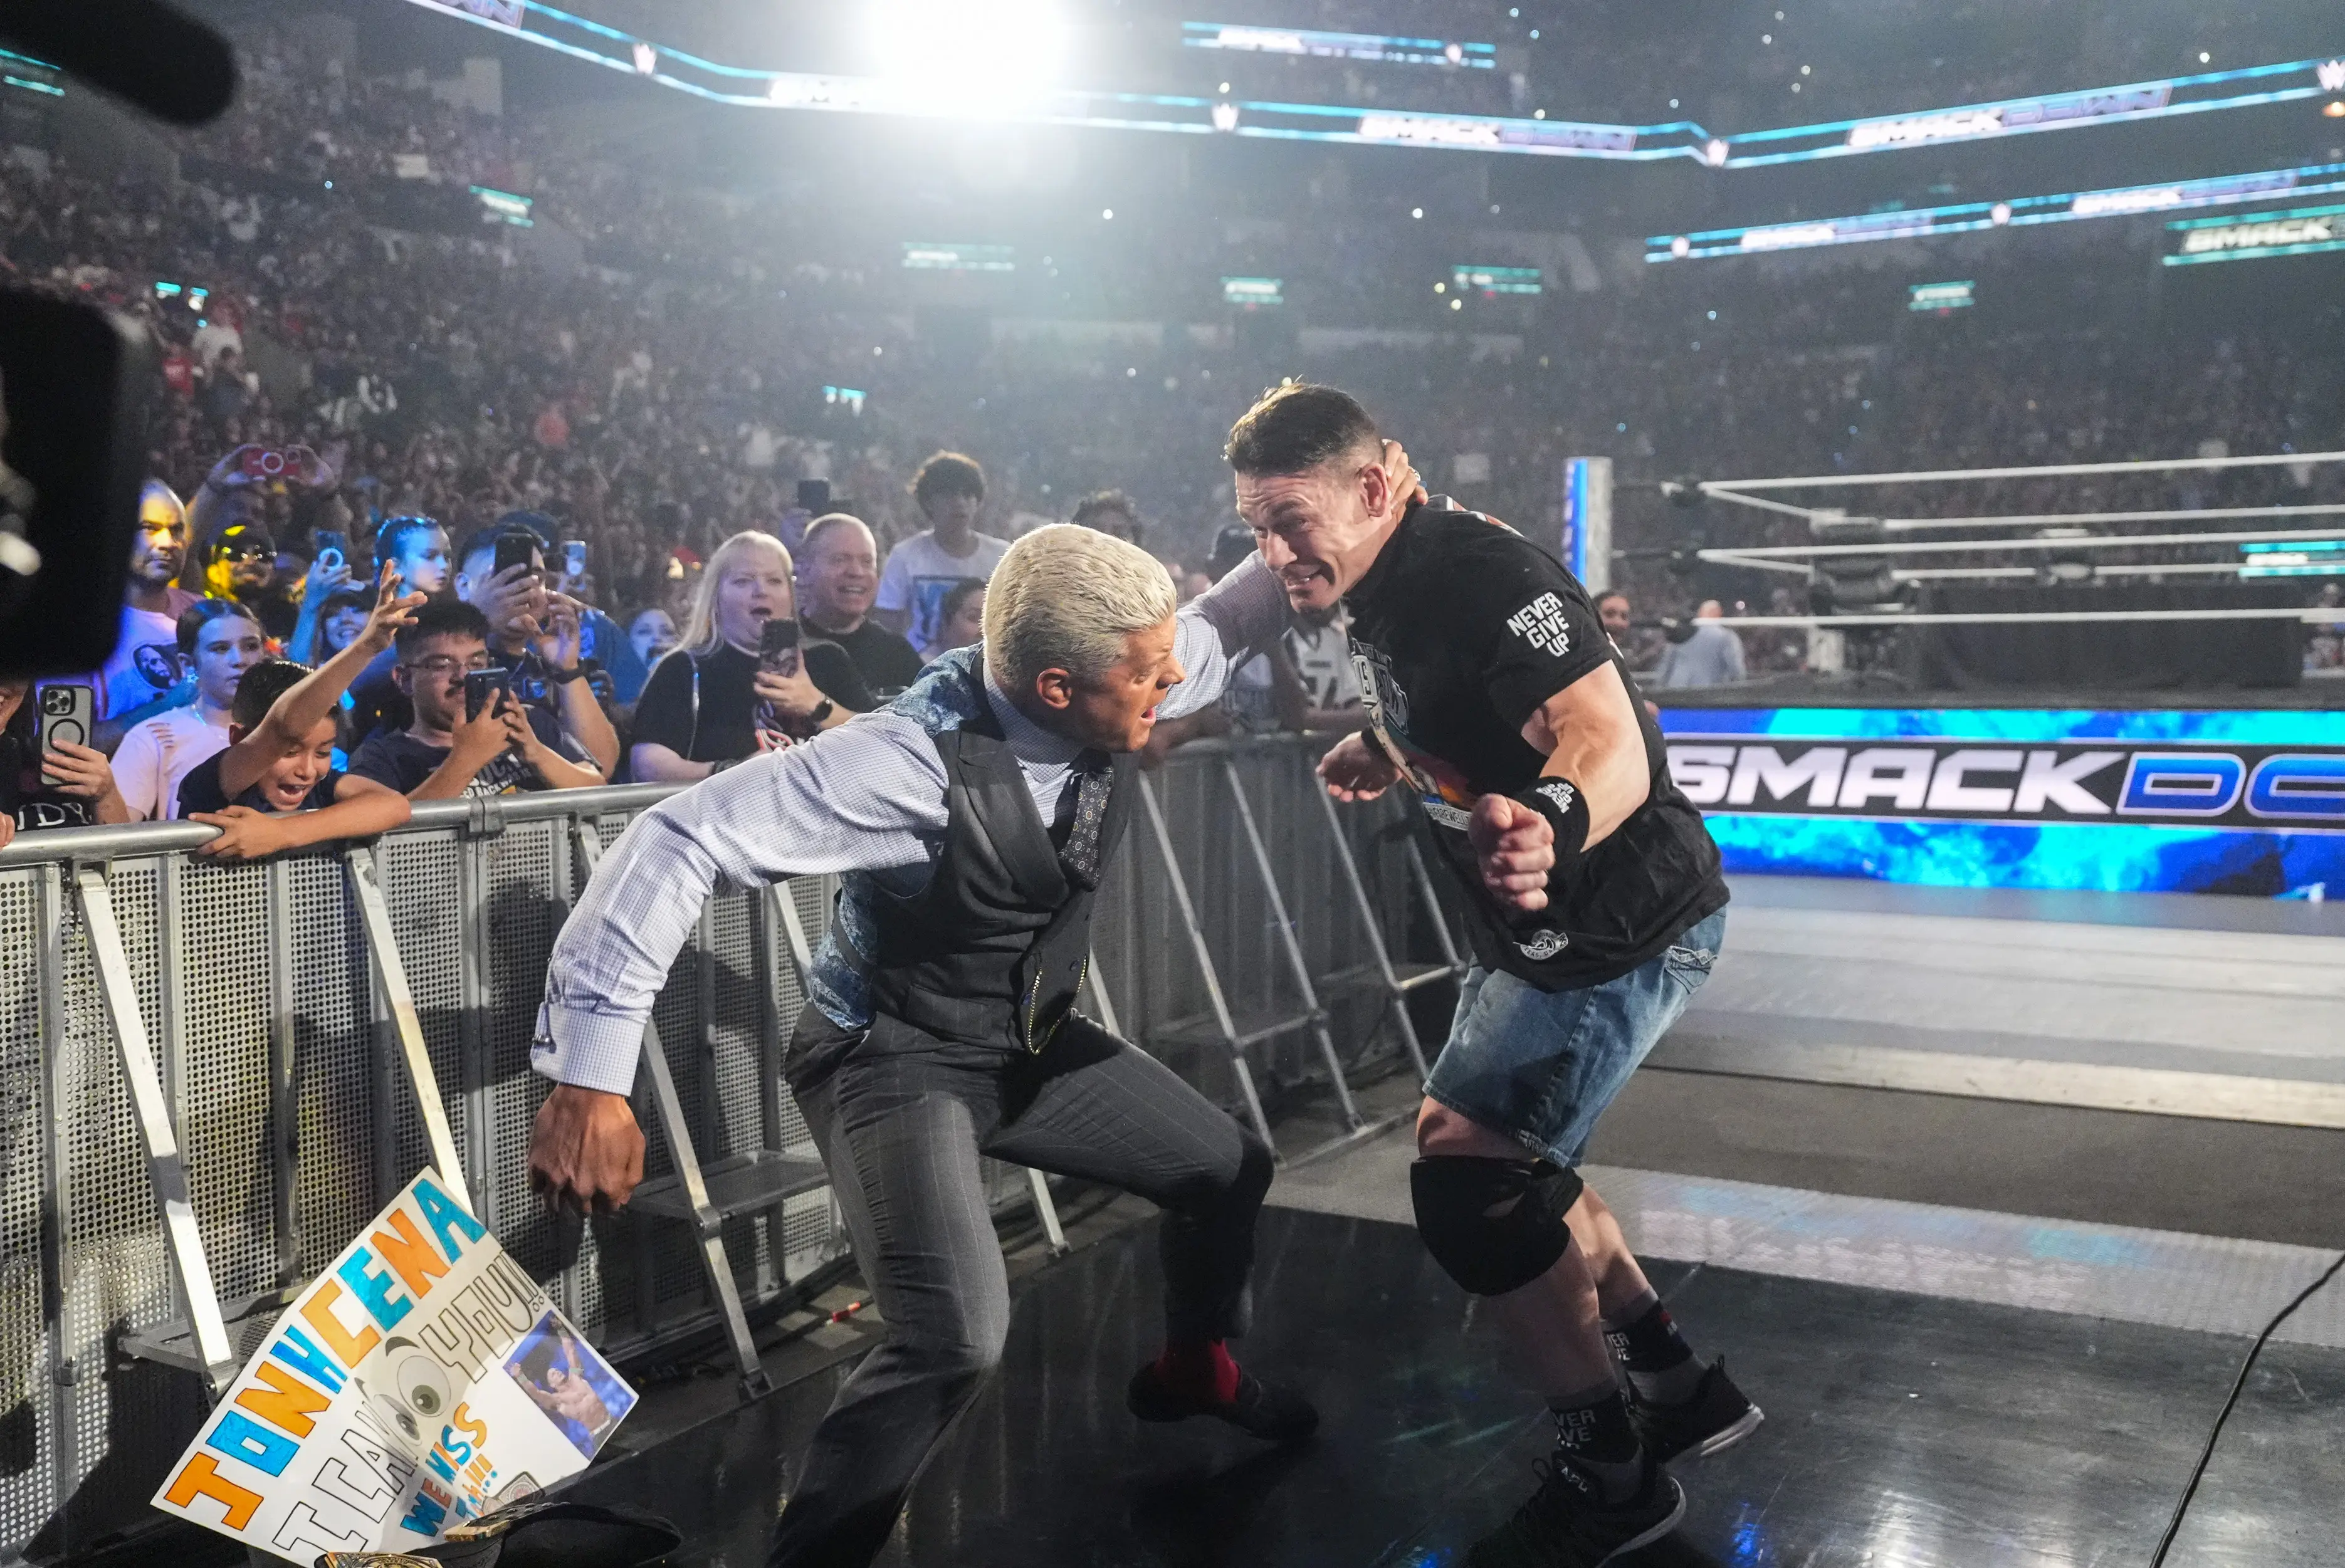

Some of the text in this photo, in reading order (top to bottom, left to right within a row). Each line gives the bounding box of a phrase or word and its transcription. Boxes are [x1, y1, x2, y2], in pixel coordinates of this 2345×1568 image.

[1506, 592, 1563, 637] NEVER
[1526, 610, 1570, 649] GIVE
[1546, 632, 1570, 657] UP
[299, 1178, 488, 1369] CENA
[399, 1401, 488, 1537] WE MISS
